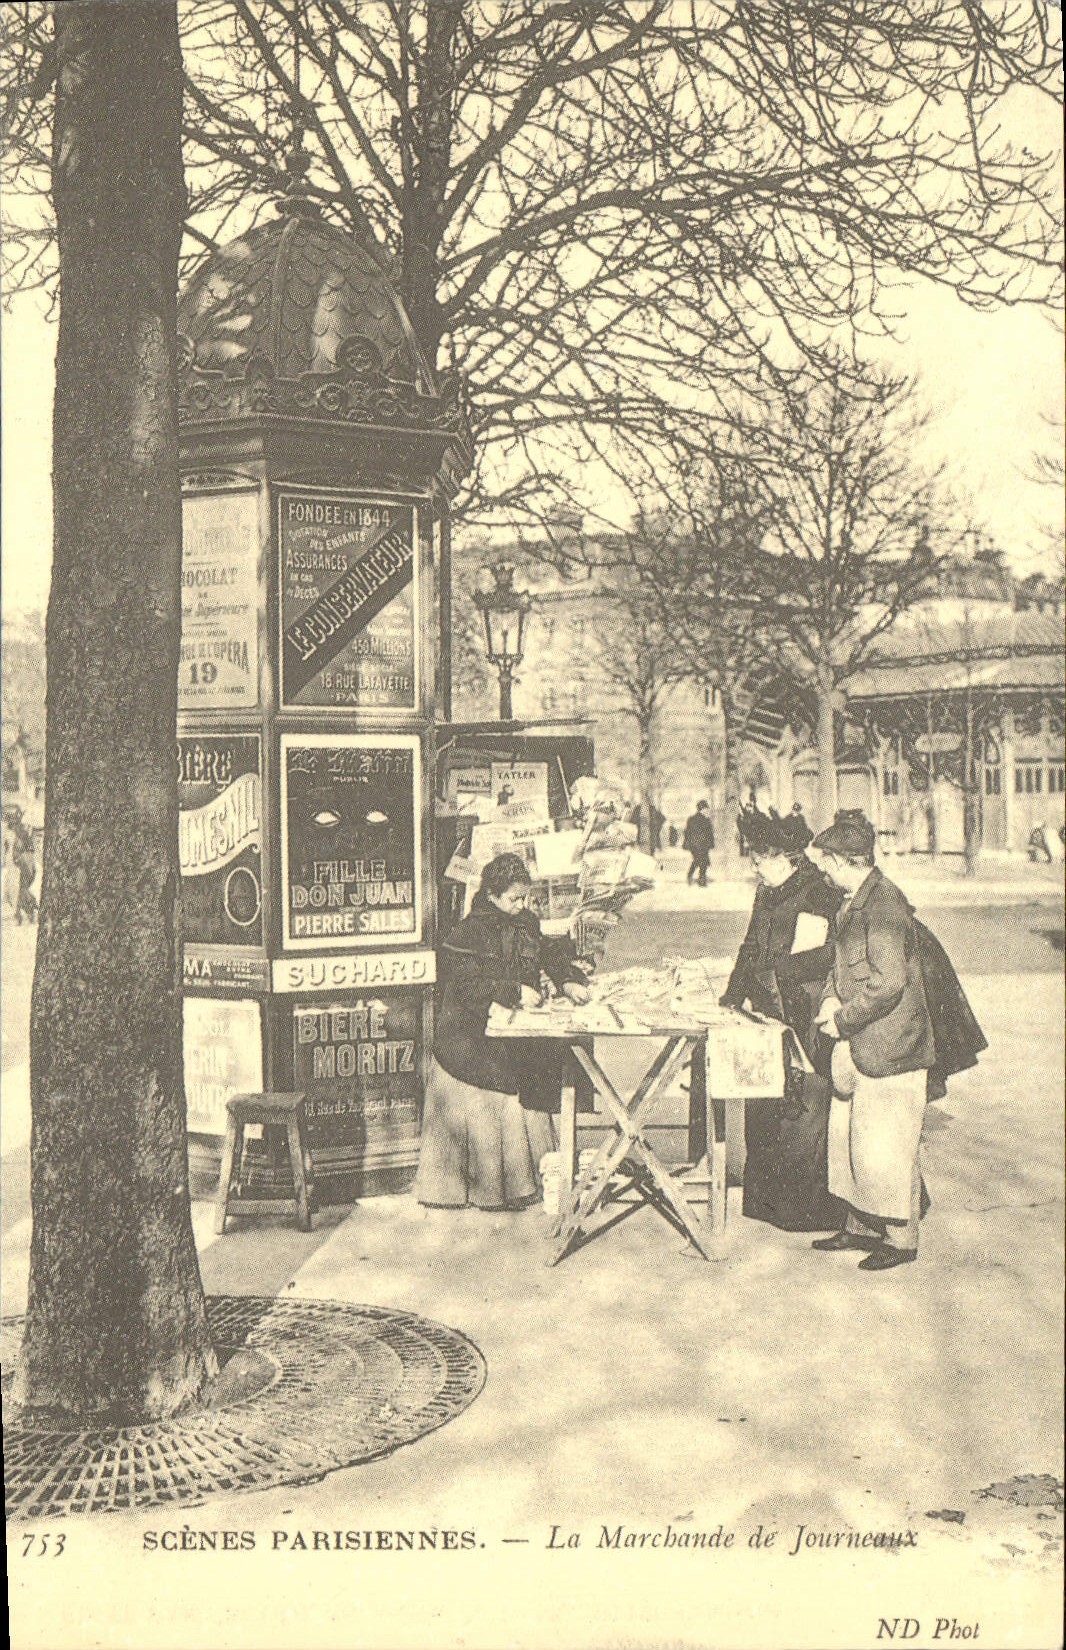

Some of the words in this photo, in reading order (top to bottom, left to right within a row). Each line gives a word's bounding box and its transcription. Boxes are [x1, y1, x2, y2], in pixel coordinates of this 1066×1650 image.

[344, 510, 357, 526] EN
[359, 508, 390, 528] 1844
[326, 529, 365, 552] ENFANTS
[286, 548, 348, 571] ASSURANCES
[303, 529, 413, 645] CONSERVATEUR
[190, 661, 218, 685] 19
[335, 673, 355, 689] RUE
[359, 676, 409, 690] LAFAYETTE
[335, 692, 389, 704] PARIS
[313, 859, 387, 884] FILLE
[291, 884, 345, 908] DON
[349, 881, 413, 906] JUAN
[295, 913, 355, 935] PIERRE
[359, 909, 412, 933] SALES
[289, 959, 427, 988] SUCHARD
[313, 1040, 415, 1079] MORITZ
